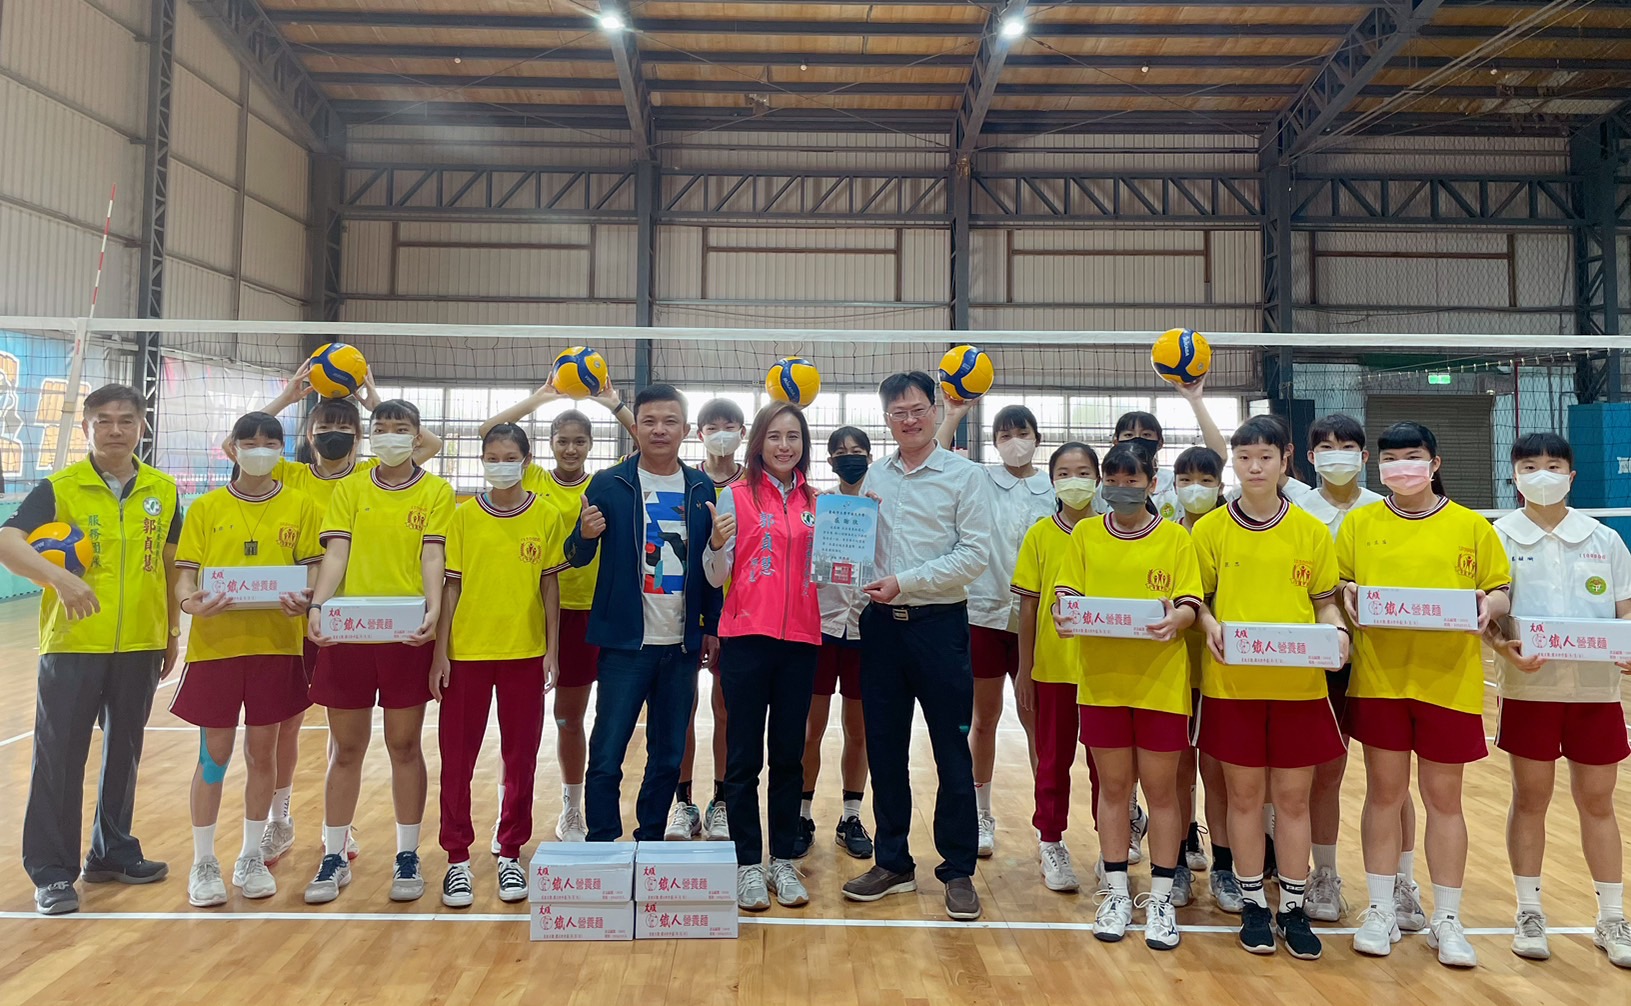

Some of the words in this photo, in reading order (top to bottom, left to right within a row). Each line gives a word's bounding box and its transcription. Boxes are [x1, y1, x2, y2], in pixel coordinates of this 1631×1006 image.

[143, 517, 157, 572] 郭貞慧
[760, 511, 776, 576] 郭貞慧
